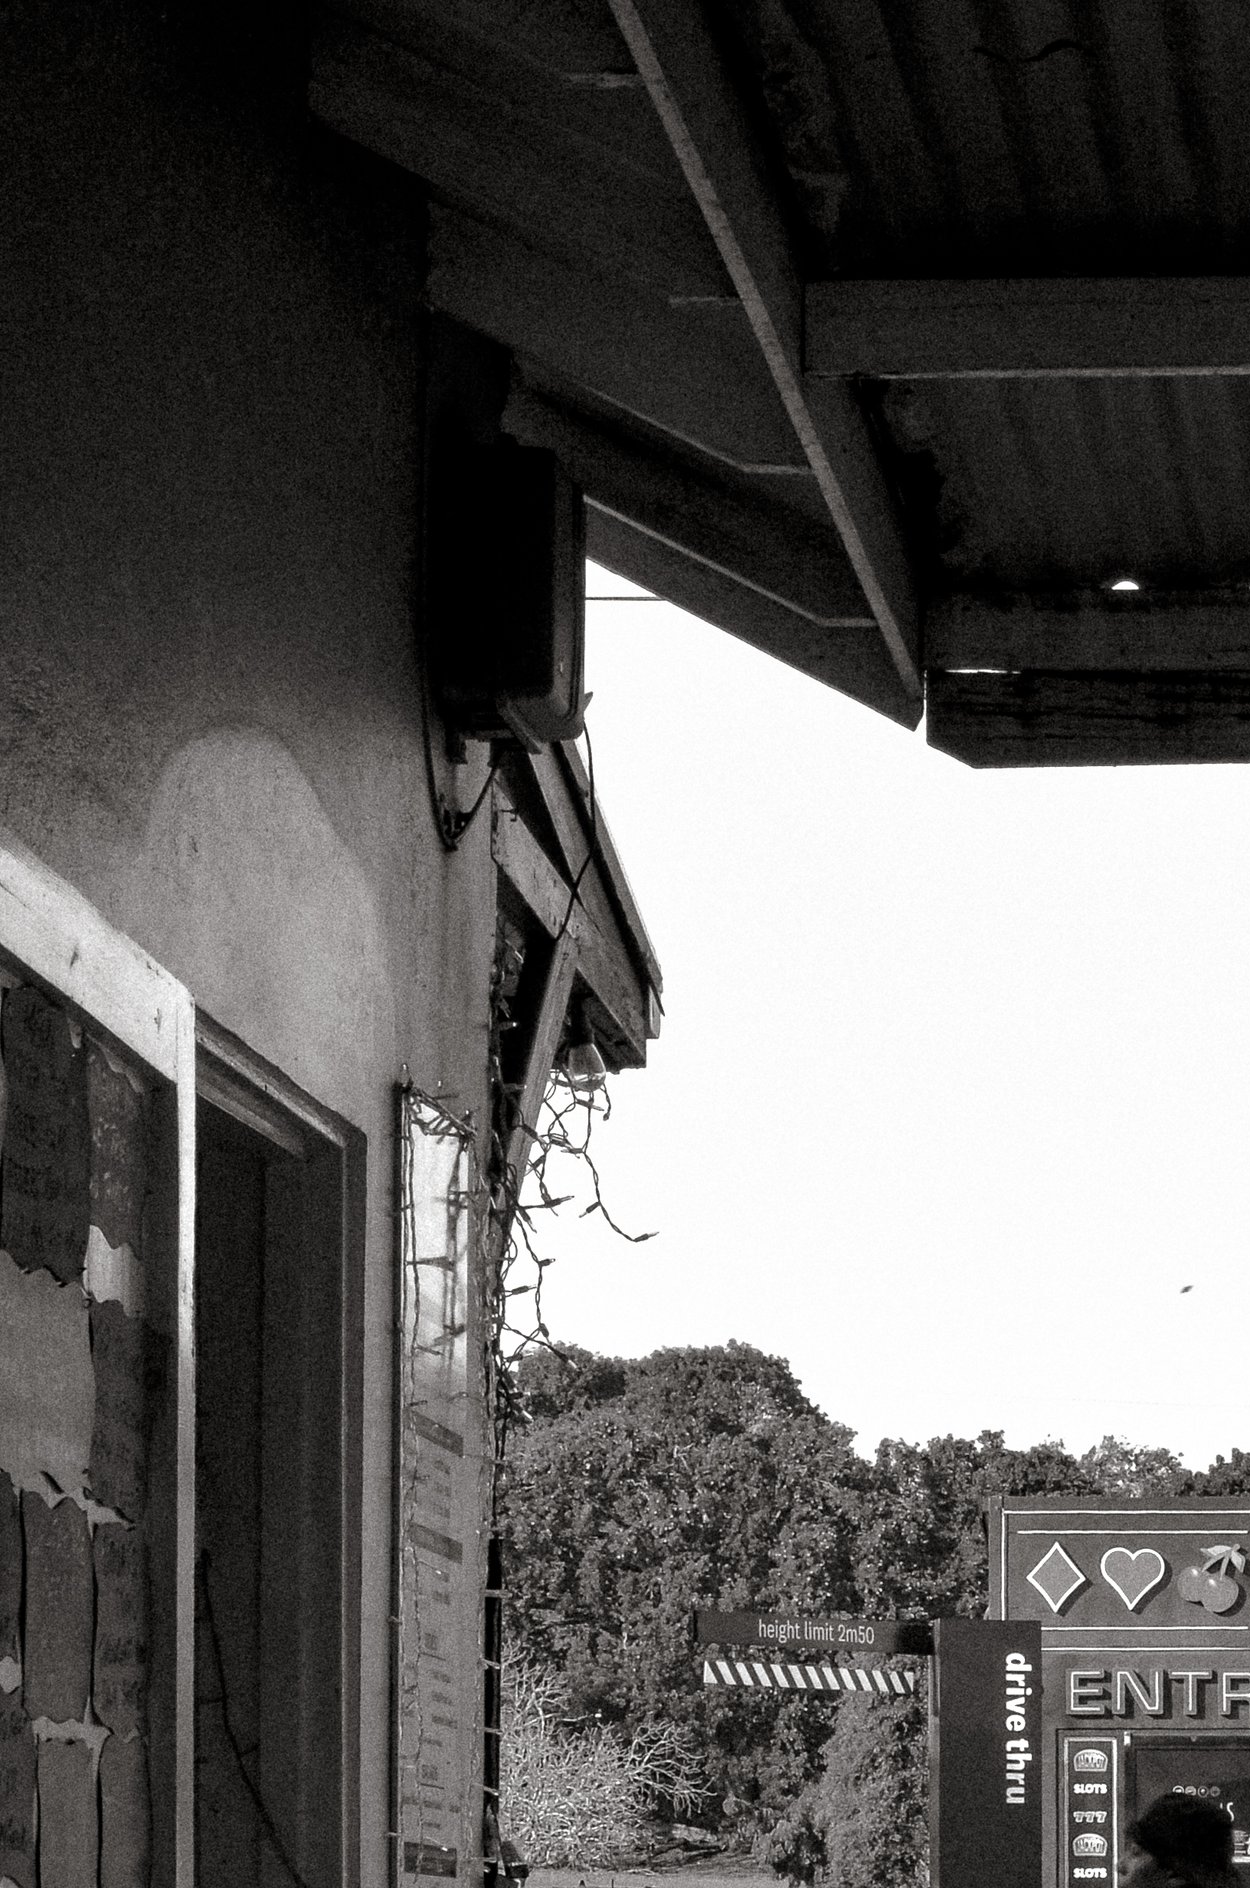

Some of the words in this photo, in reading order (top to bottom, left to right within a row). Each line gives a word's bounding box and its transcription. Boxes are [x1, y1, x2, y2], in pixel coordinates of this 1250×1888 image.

[758, 1619, 801, 1644] height
[804, 1621, 835, 1642] limit
[838, 1624, 875, 1645] 2m50
[1005, 1652, 1032, 1732] drive
[1006, 1740, 1033, 1804] thru
[1073, 1783, 1108, 1794] SLOTS
[1073, 1811, 1108, 1823] 777
[1073, 1868, 1108, 1879] SLOTS
